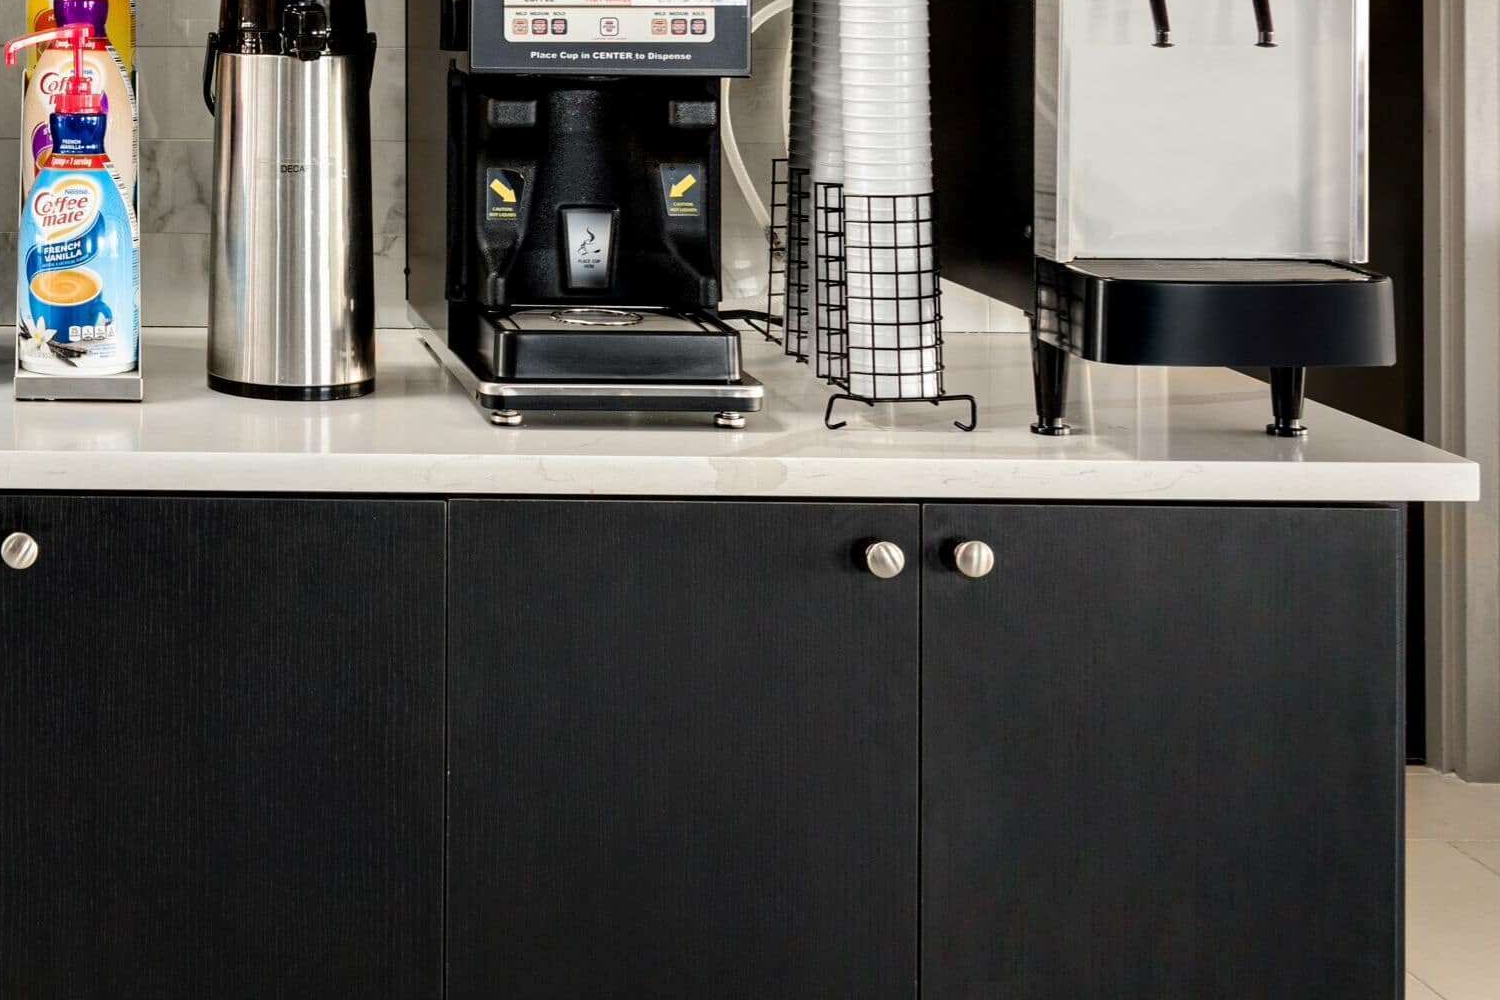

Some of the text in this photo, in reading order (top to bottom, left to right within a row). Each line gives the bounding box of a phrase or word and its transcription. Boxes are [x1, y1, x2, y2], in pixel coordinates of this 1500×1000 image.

[530, 51, 692, 62] Place Cup in CENTER to Dispense
[280, 164, 311, 173] DECA
[34, 191, 89, 216] Coffee
[42, 209, 85, 228] mate
[43, 240, 82, 255] FRENCH
[44, 248, 83, 263] VANILLA
